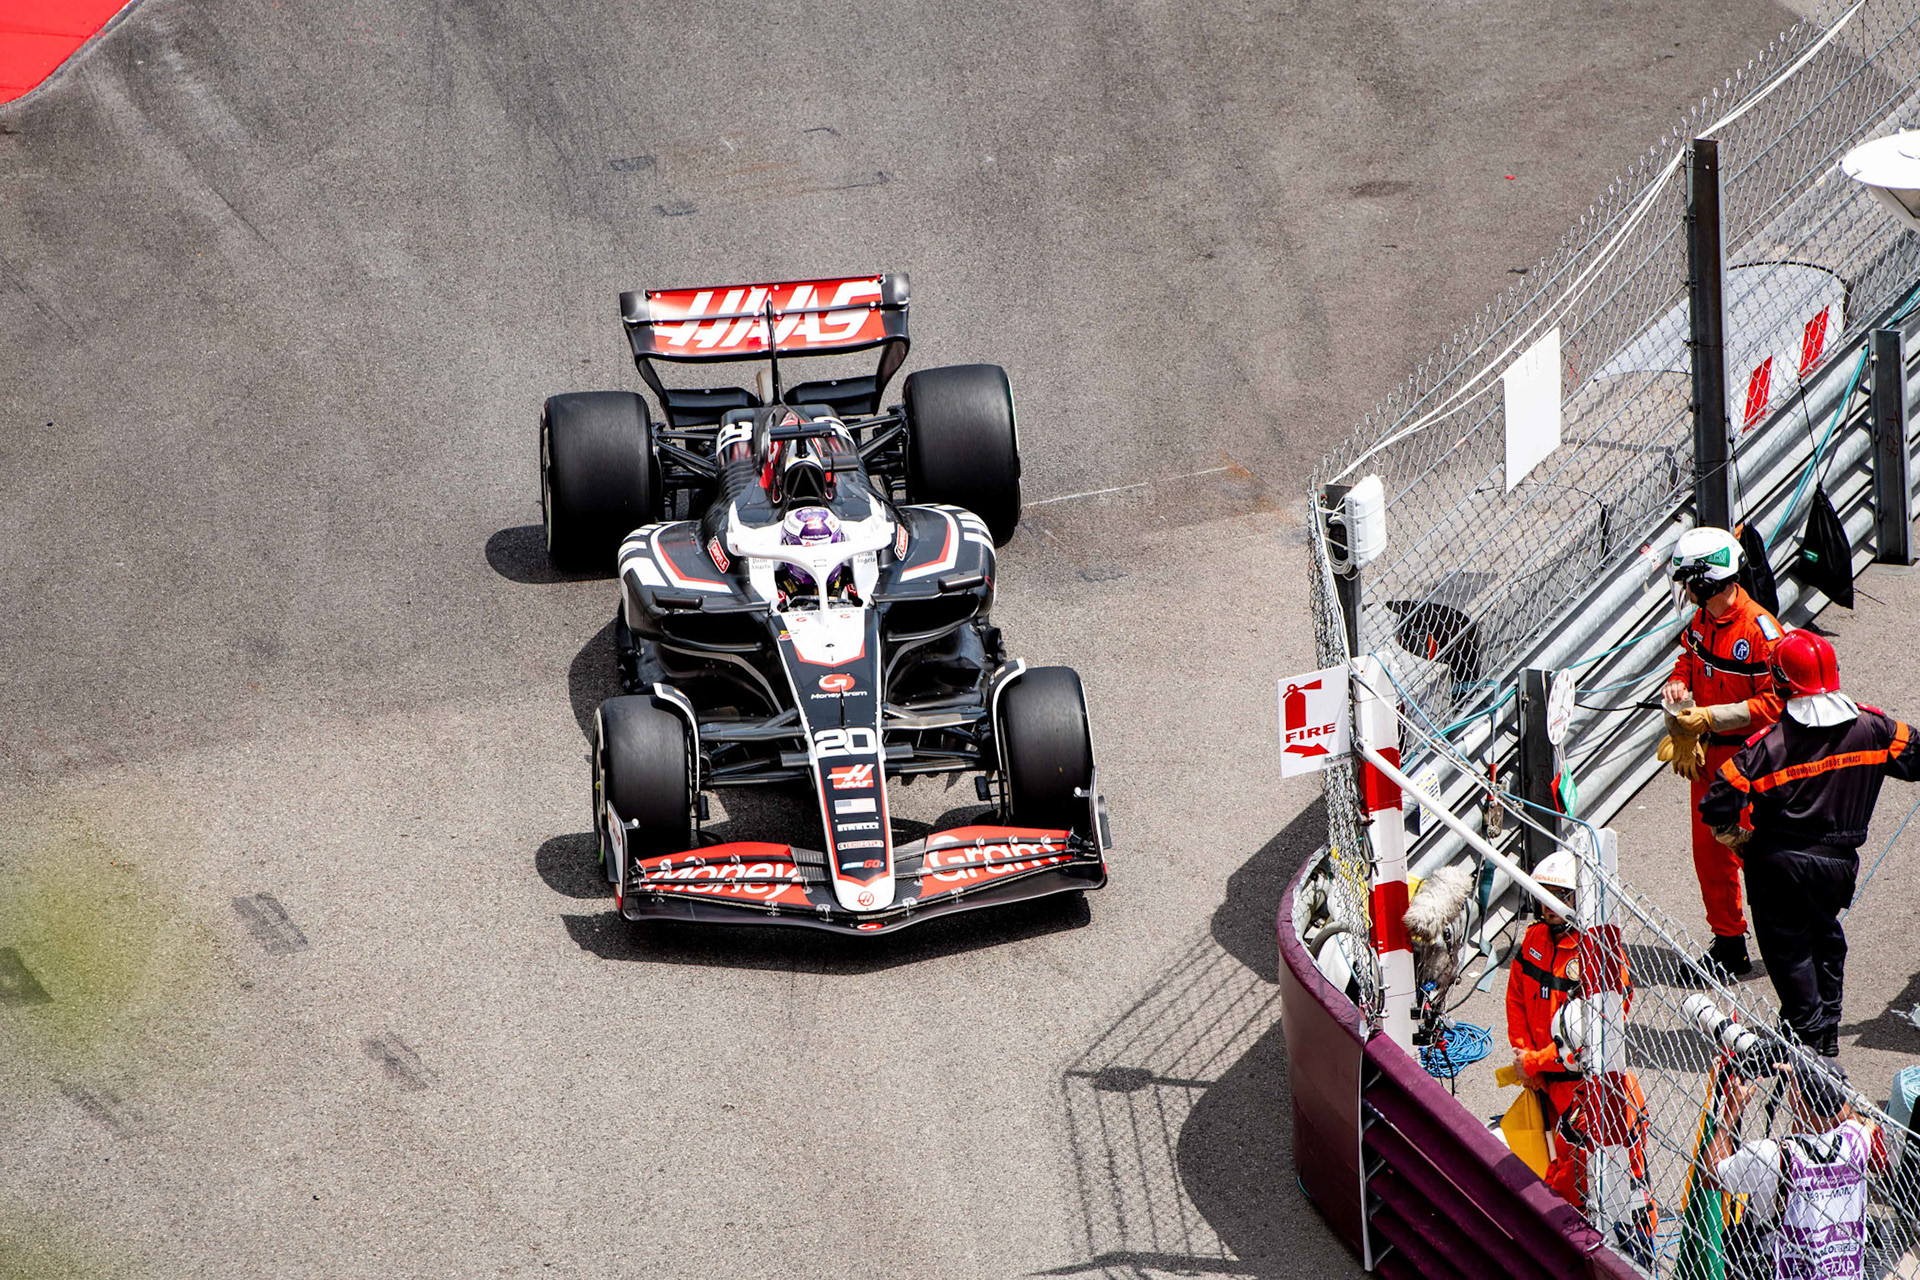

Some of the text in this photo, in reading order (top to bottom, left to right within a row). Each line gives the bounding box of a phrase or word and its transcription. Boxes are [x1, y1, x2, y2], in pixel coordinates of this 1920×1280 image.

[653, 279, 882, 348] HAAS
[814, 728, 878, 759] 20
[1285, 723, 1336, 744] FIRE
[1786, 764, 1821, 776] AUTOMOBILE
[645, 835, 1060, 900] Money Gram
[1541, 986, 1549, 999] 11
